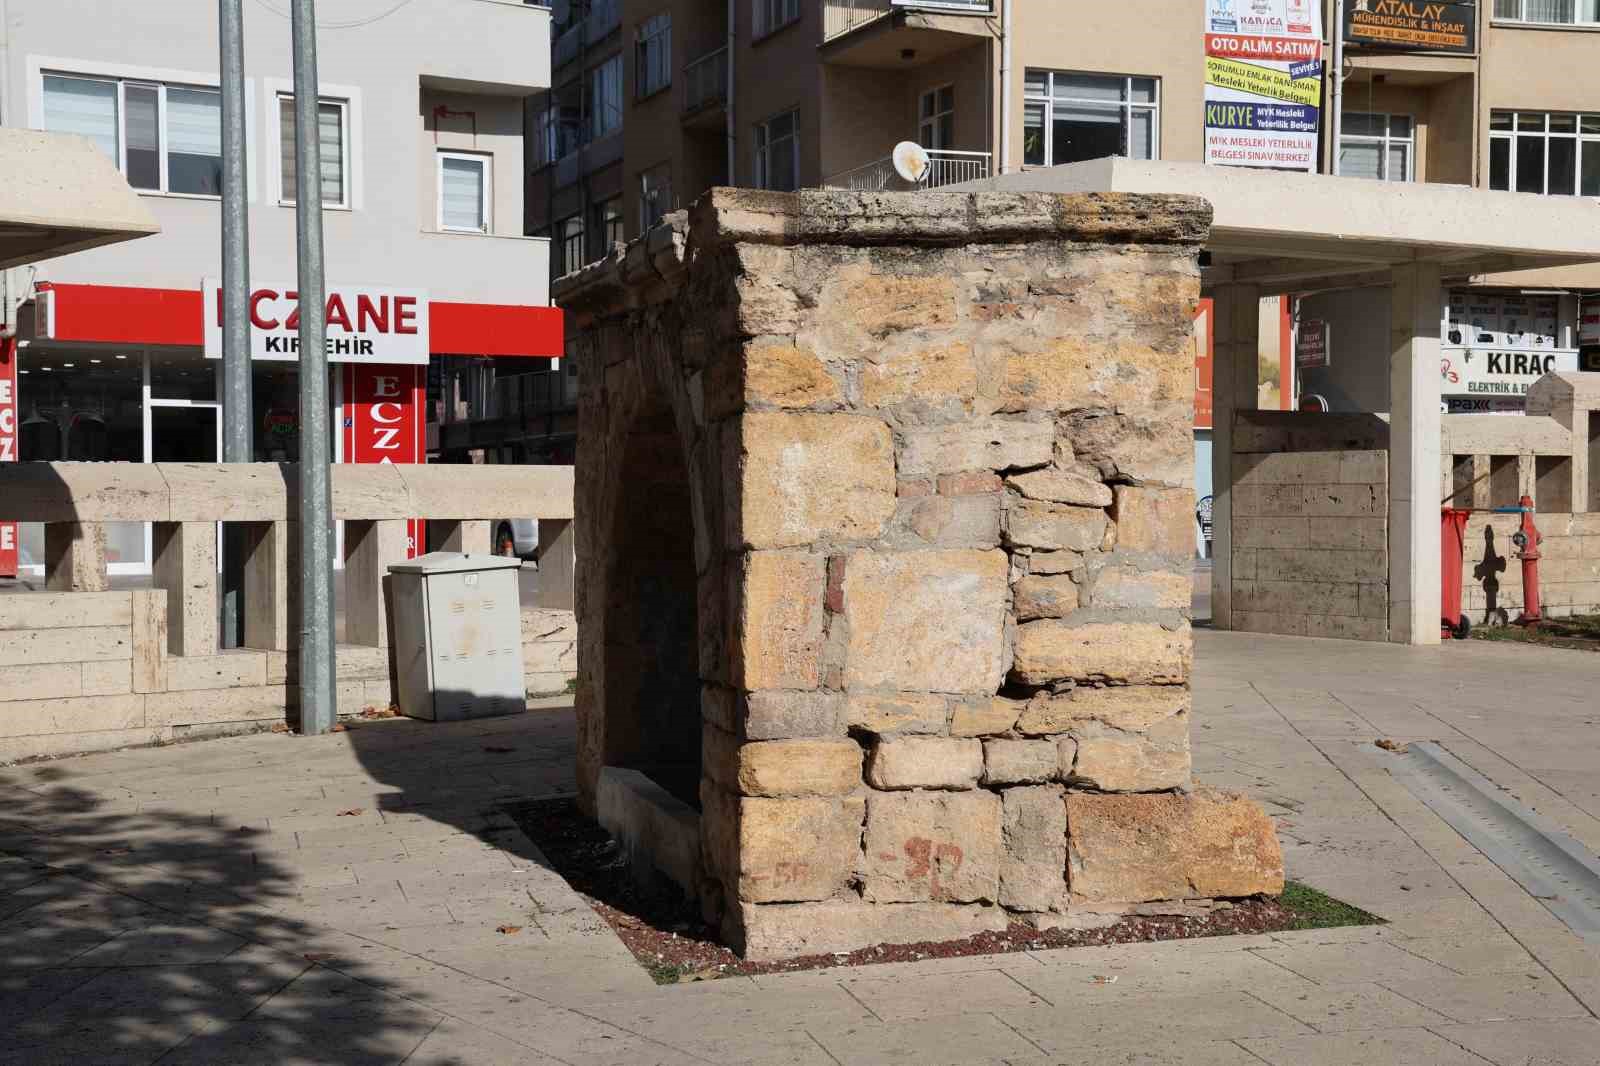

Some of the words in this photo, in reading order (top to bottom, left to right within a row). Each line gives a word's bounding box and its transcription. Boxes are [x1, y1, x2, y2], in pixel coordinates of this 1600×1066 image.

[1375, 0, 1445, 20] ATALAY
[1211, 37, 1239, 51] OTO
[1275, 41, 1314, 57] SATIM
[1207, 104, 1253, 127] KURYE
[217, 288, 418, 335] CANE
[265, 335, 375, 356] KIREHİR
[1468, 380, 1511, 393] ELEKTRİK
[1512, 383, 1519, 393] &
[370, 376, 402, 464] ECZ
